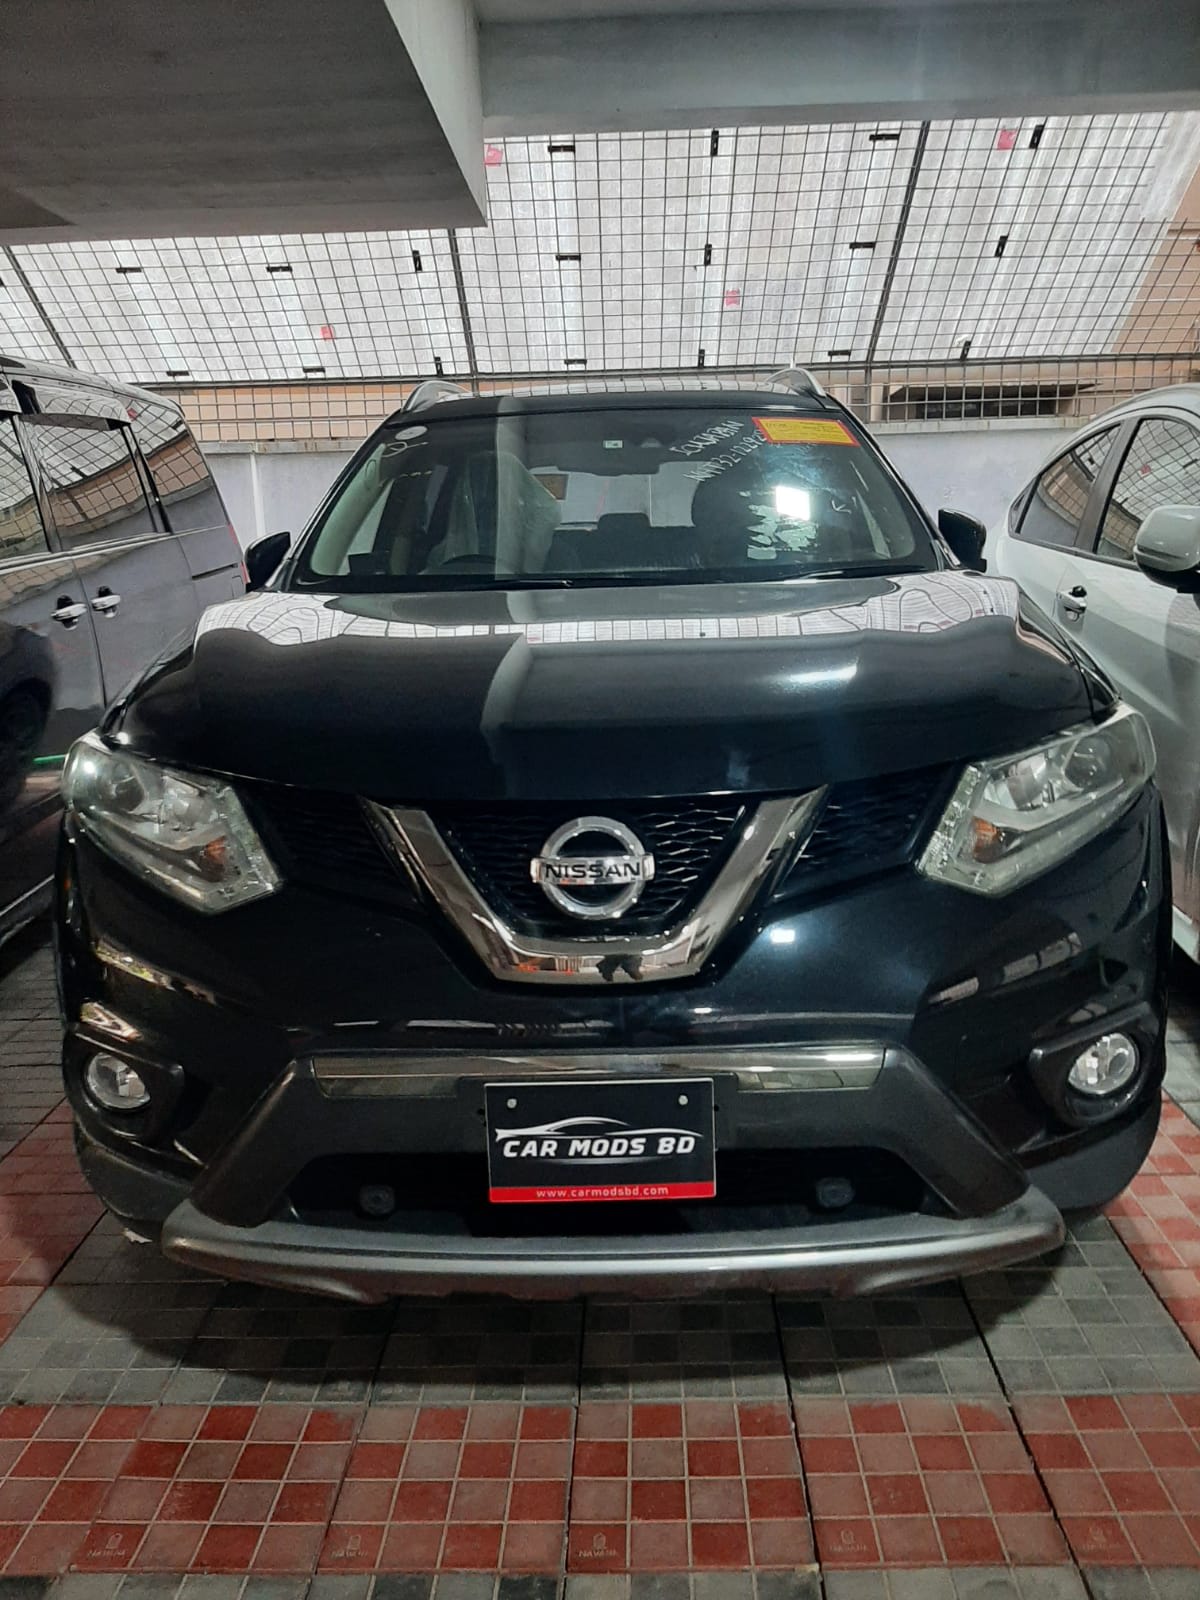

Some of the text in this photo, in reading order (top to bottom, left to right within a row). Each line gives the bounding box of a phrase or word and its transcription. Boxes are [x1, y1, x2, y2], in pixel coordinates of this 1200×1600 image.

[545, 863, 640, 879] NISSAN
[503, 1136, 696, 1158] CAR MODS BD
[536, 1186, 669, 1198] www.carmodsbd.com
